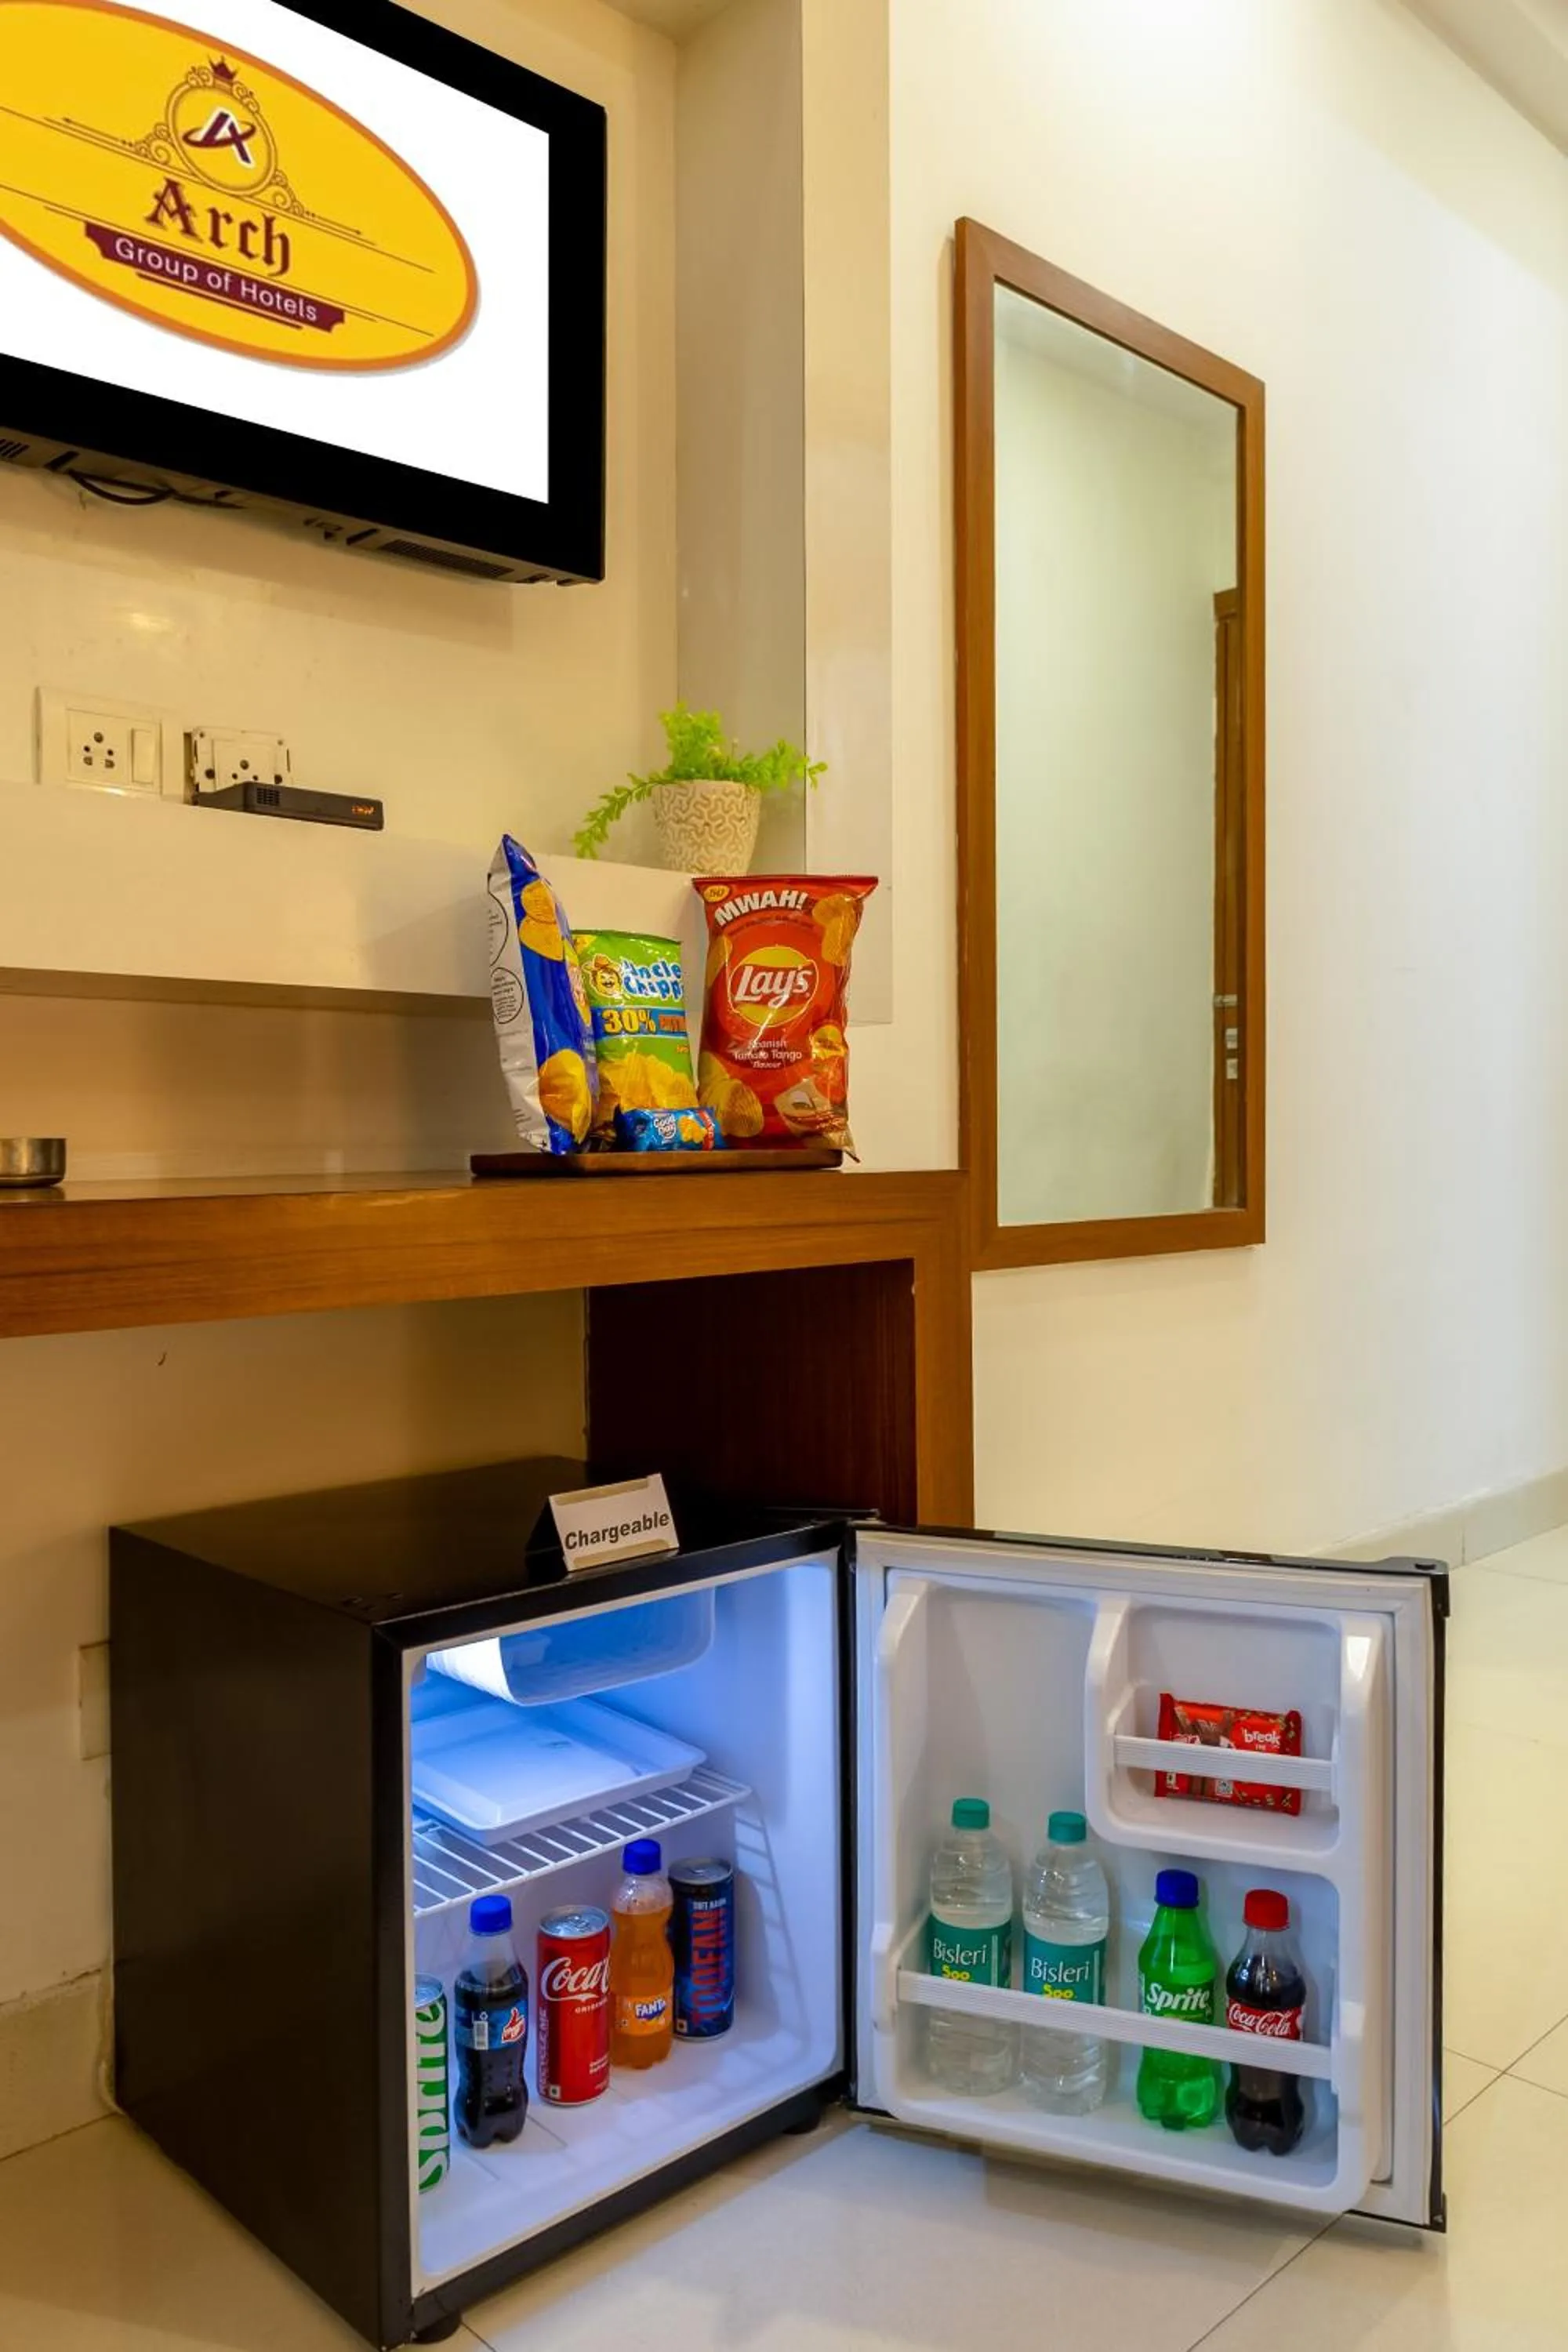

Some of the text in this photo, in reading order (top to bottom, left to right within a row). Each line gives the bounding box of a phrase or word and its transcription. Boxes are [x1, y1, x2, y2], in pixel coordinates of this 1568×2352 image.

[144, 176, 291, 278] Arch
[114, 238, 318, 321] Group of Hotels
[714, 889, 808, 927] MWAH!
[622, 958, 682, 980] Uncle
[622, 975, 684, 1001] Chipp
[734, 965, 813, 1008] Lay's
[601, 1008, 656, 1034] 30%
[771, 1048, 803, 1062] Tango
[564, 1512, 670, 1550] Chargeable
[1244, 1727, 1281, 1746] break
[933, 1937, 988, 1966] Bisleri
[1031, 1957, 1090, 1984] Bisleri
[1146, 1982, 1210, 2012] Sprite
[1229, 2003, 1293, 2036] Coca-Cola
